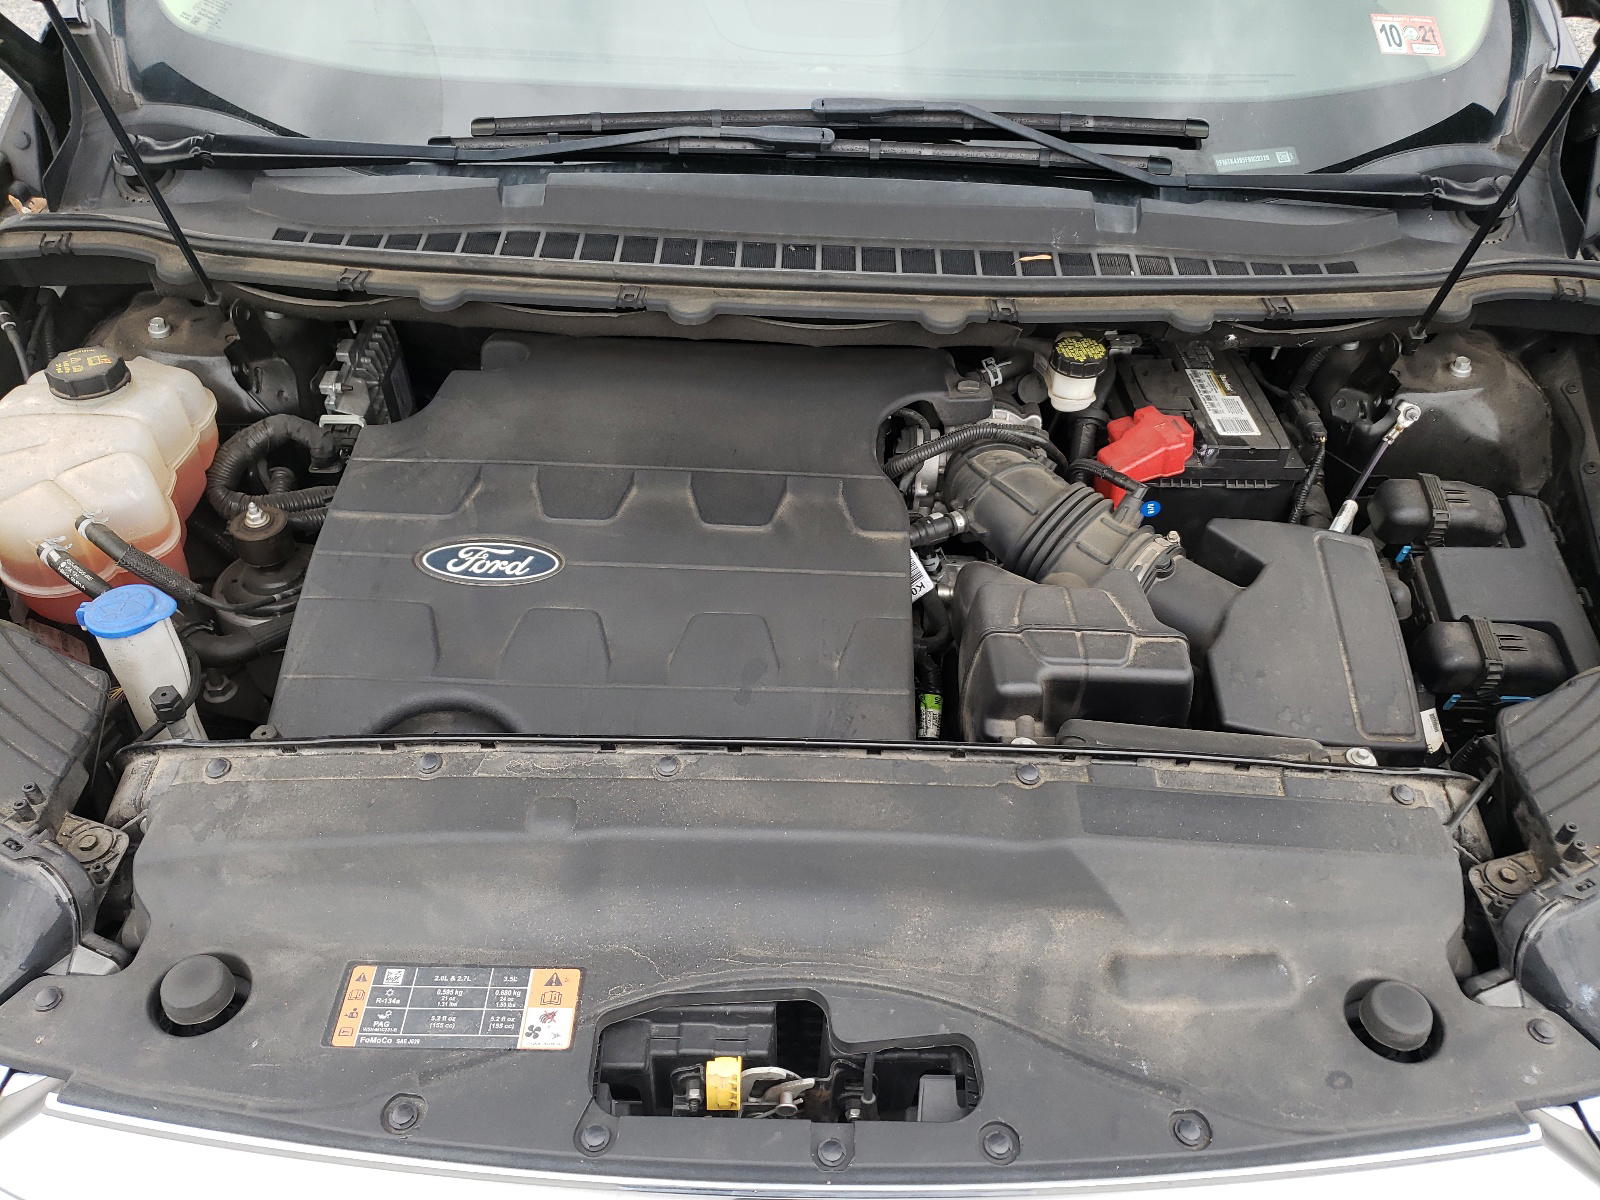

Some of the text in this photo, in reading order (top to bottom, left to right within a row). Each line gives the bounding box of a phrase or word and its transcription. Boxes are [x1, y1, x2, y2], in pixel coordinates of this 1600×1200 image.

[1380, 24, 1403, 48] 10
[1418, 25, 1437, 42] 21
[446, 546, 535, 576] Ford
[455, 989, 464, 997] kg
[512, 989, 522, 997] kg
[375, 997, 401, 1005] R-134a
[373, 1020, 391, 1028] PAG
[360, 1036, 393, 1044] FoMoCo
